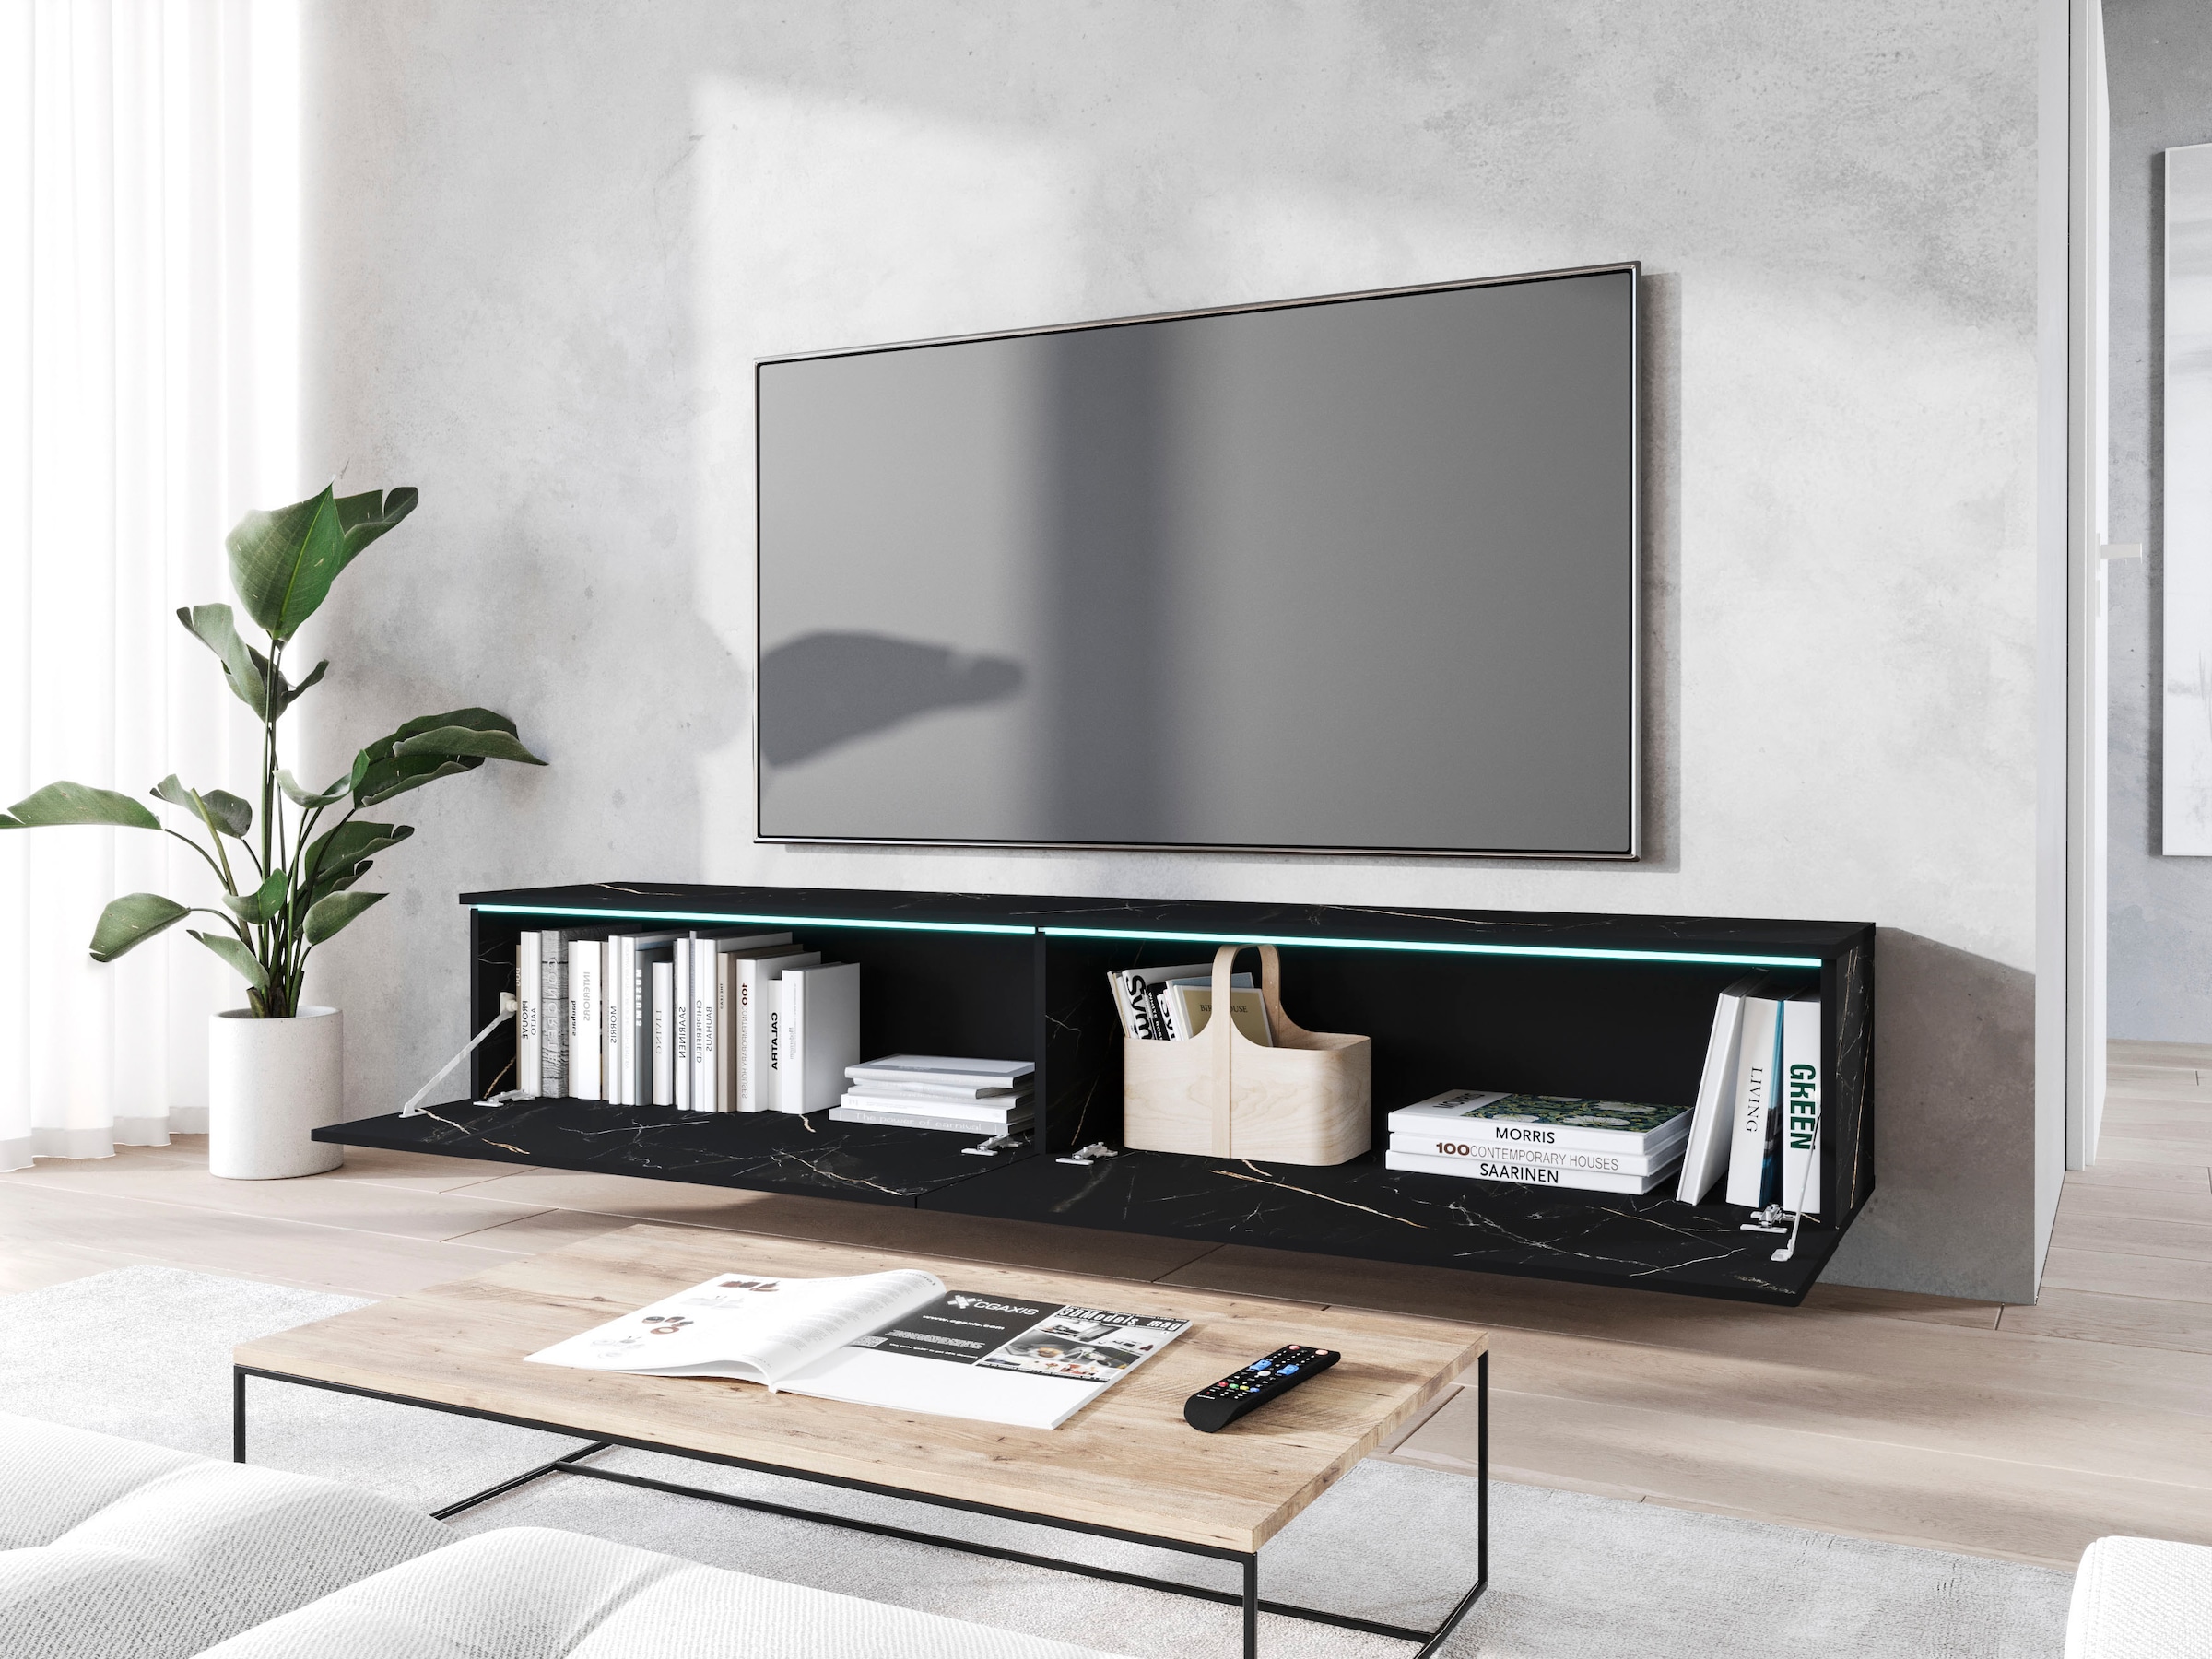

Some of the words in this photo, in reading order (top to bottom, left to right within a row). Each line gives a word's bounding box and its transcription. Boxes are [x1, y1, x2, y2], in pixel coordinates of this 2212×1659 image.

[1746, 1066, 1763, 1133] LIVING
[1789, 1063, 1817, 1151] GREEN
[1495, 1126, 1556, 1145] MORRIS
[1570, 1154, 1619, 1171] HOUSES
[1479, 1162, 1559, 1184] SAARINEN
[973, 1300, 1040, 1317] CGAXIS
[1146, 1320, 1182, 1332] mag
